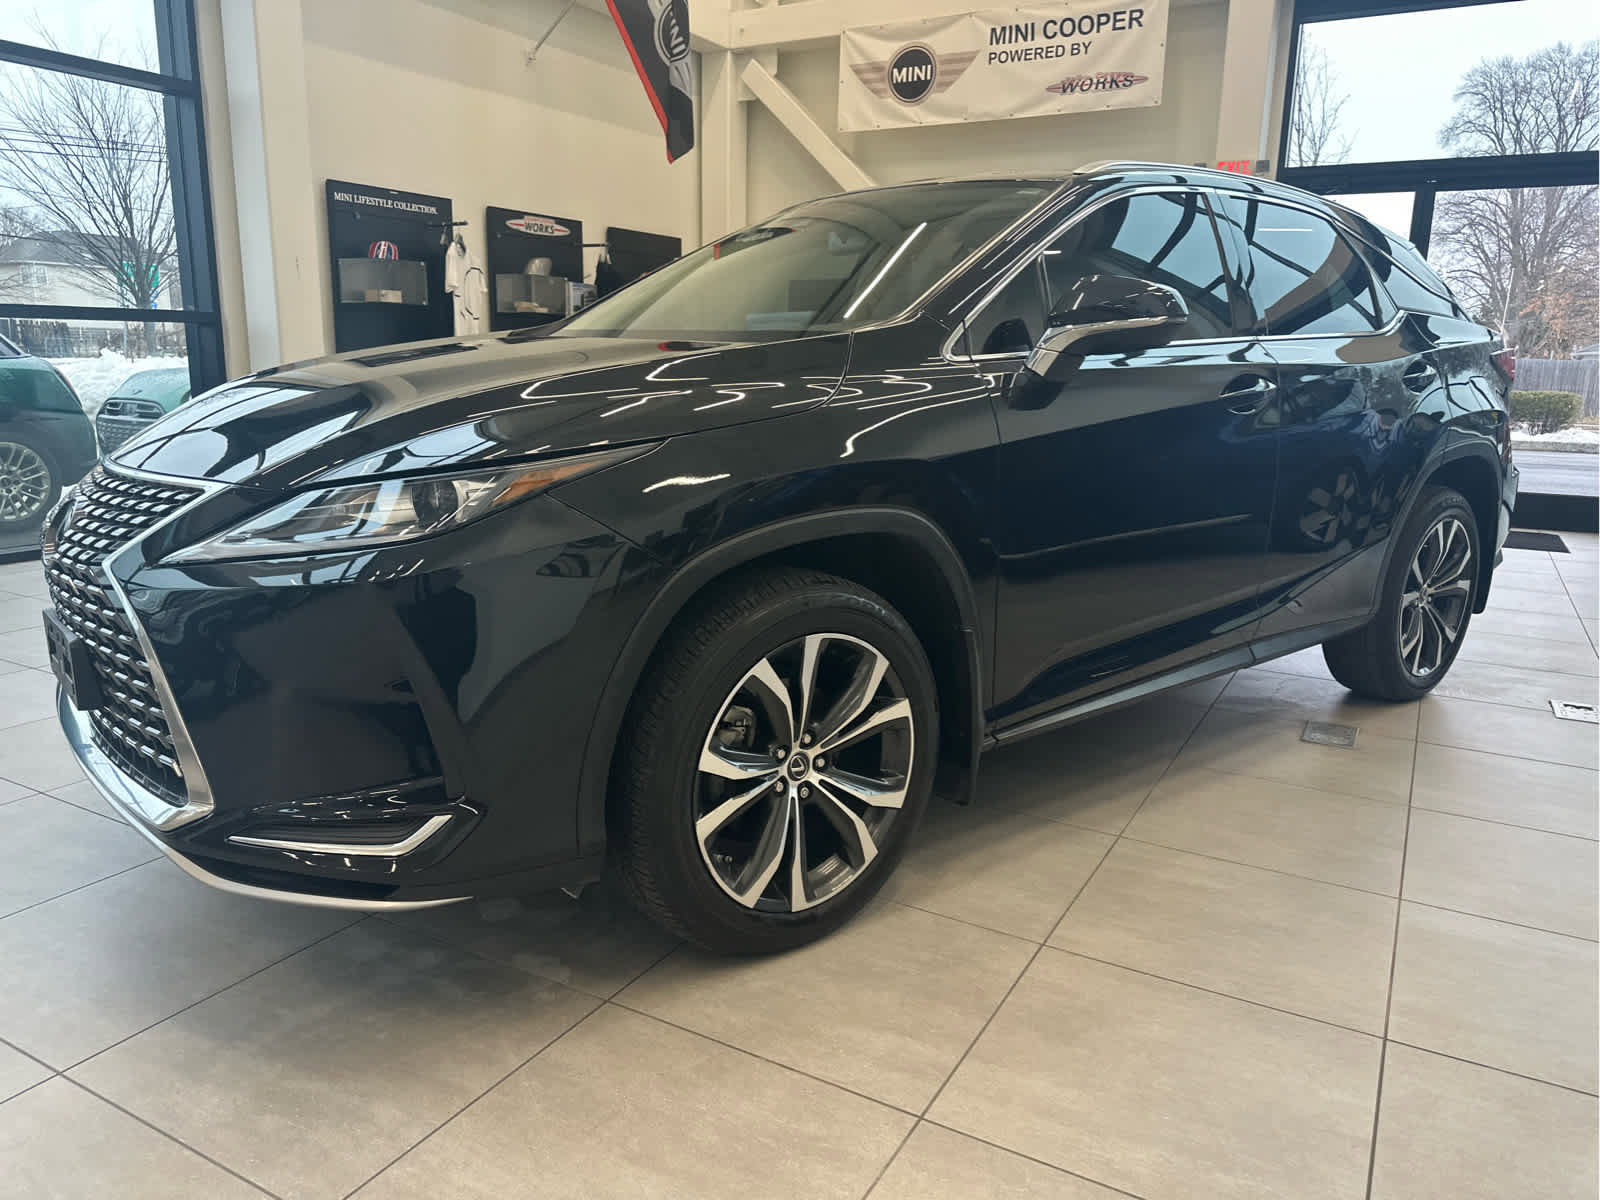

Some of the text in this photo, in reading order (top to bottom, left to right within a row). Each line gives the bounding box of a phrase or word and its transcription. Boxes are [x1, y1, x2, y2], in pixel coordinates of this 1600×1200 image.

[989, 8, 1145, 46] MINI COOPER
[988, 41, 1092, 65] POWERED BY
[892, 64, 932, 84] MINI
[1062, 75, 1134, 94] WORKS
[334, 191, 353, 203] MINI
[353, 194, 393, 209] LIFESTYLE
[524, 221, 555, 235] WORKS
